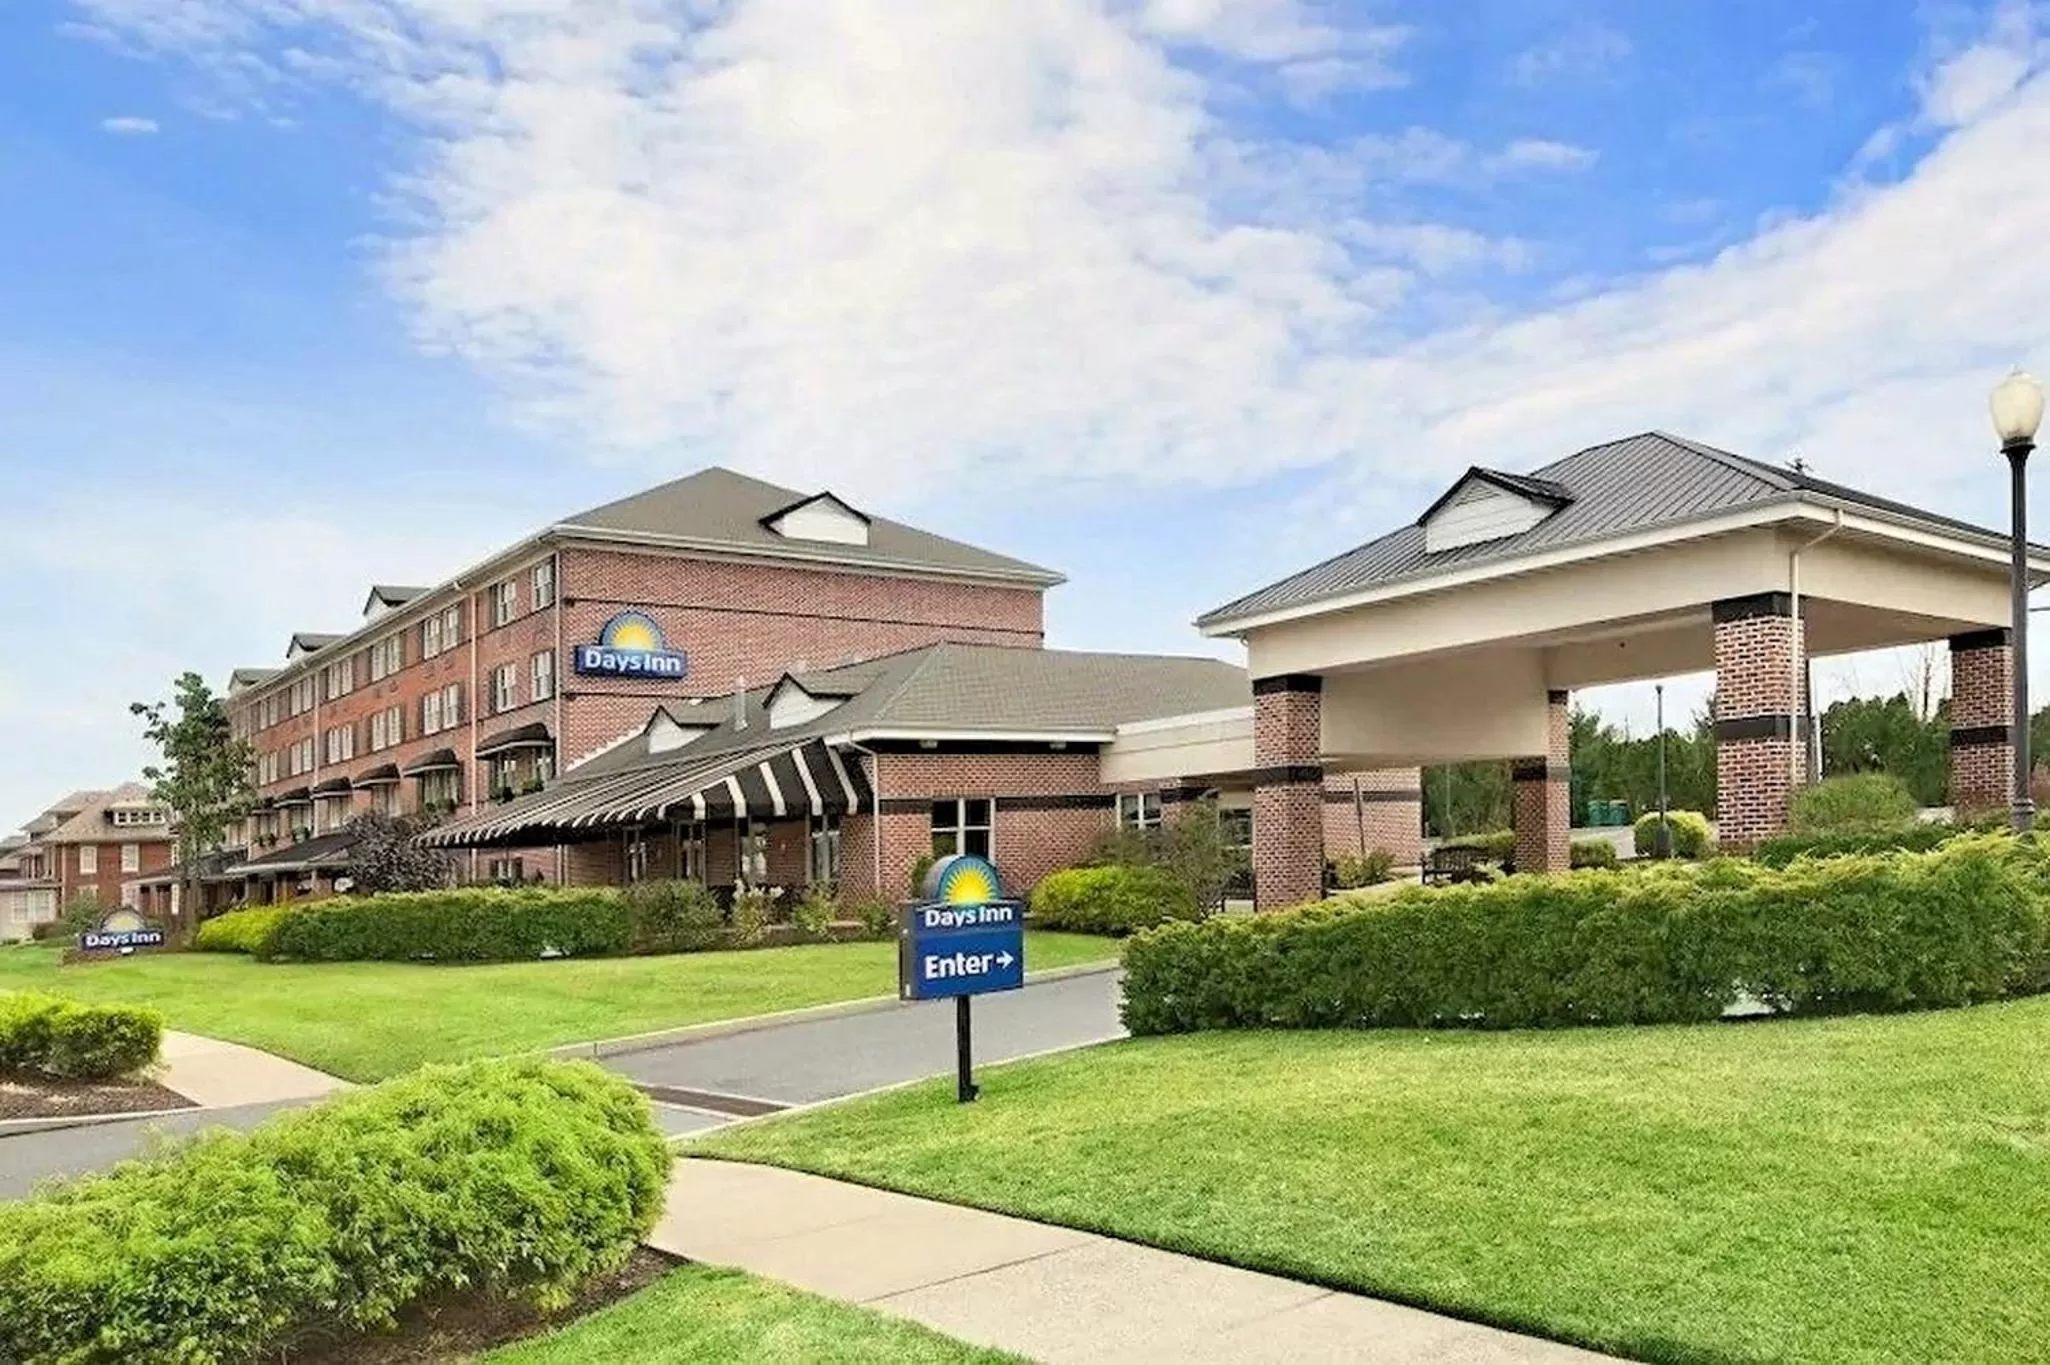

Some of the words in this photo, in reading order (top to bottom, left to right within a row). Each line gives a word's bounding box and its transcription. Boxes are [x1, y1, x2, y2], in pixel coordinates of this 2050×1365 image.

[584, 649, 642, 671] Days
[644, 653, 680, 671] Inn
[925, 908, 977, 927] Days
[979, 906, 1013, 922] Inn
[925, 952, 994, 979] Enter
